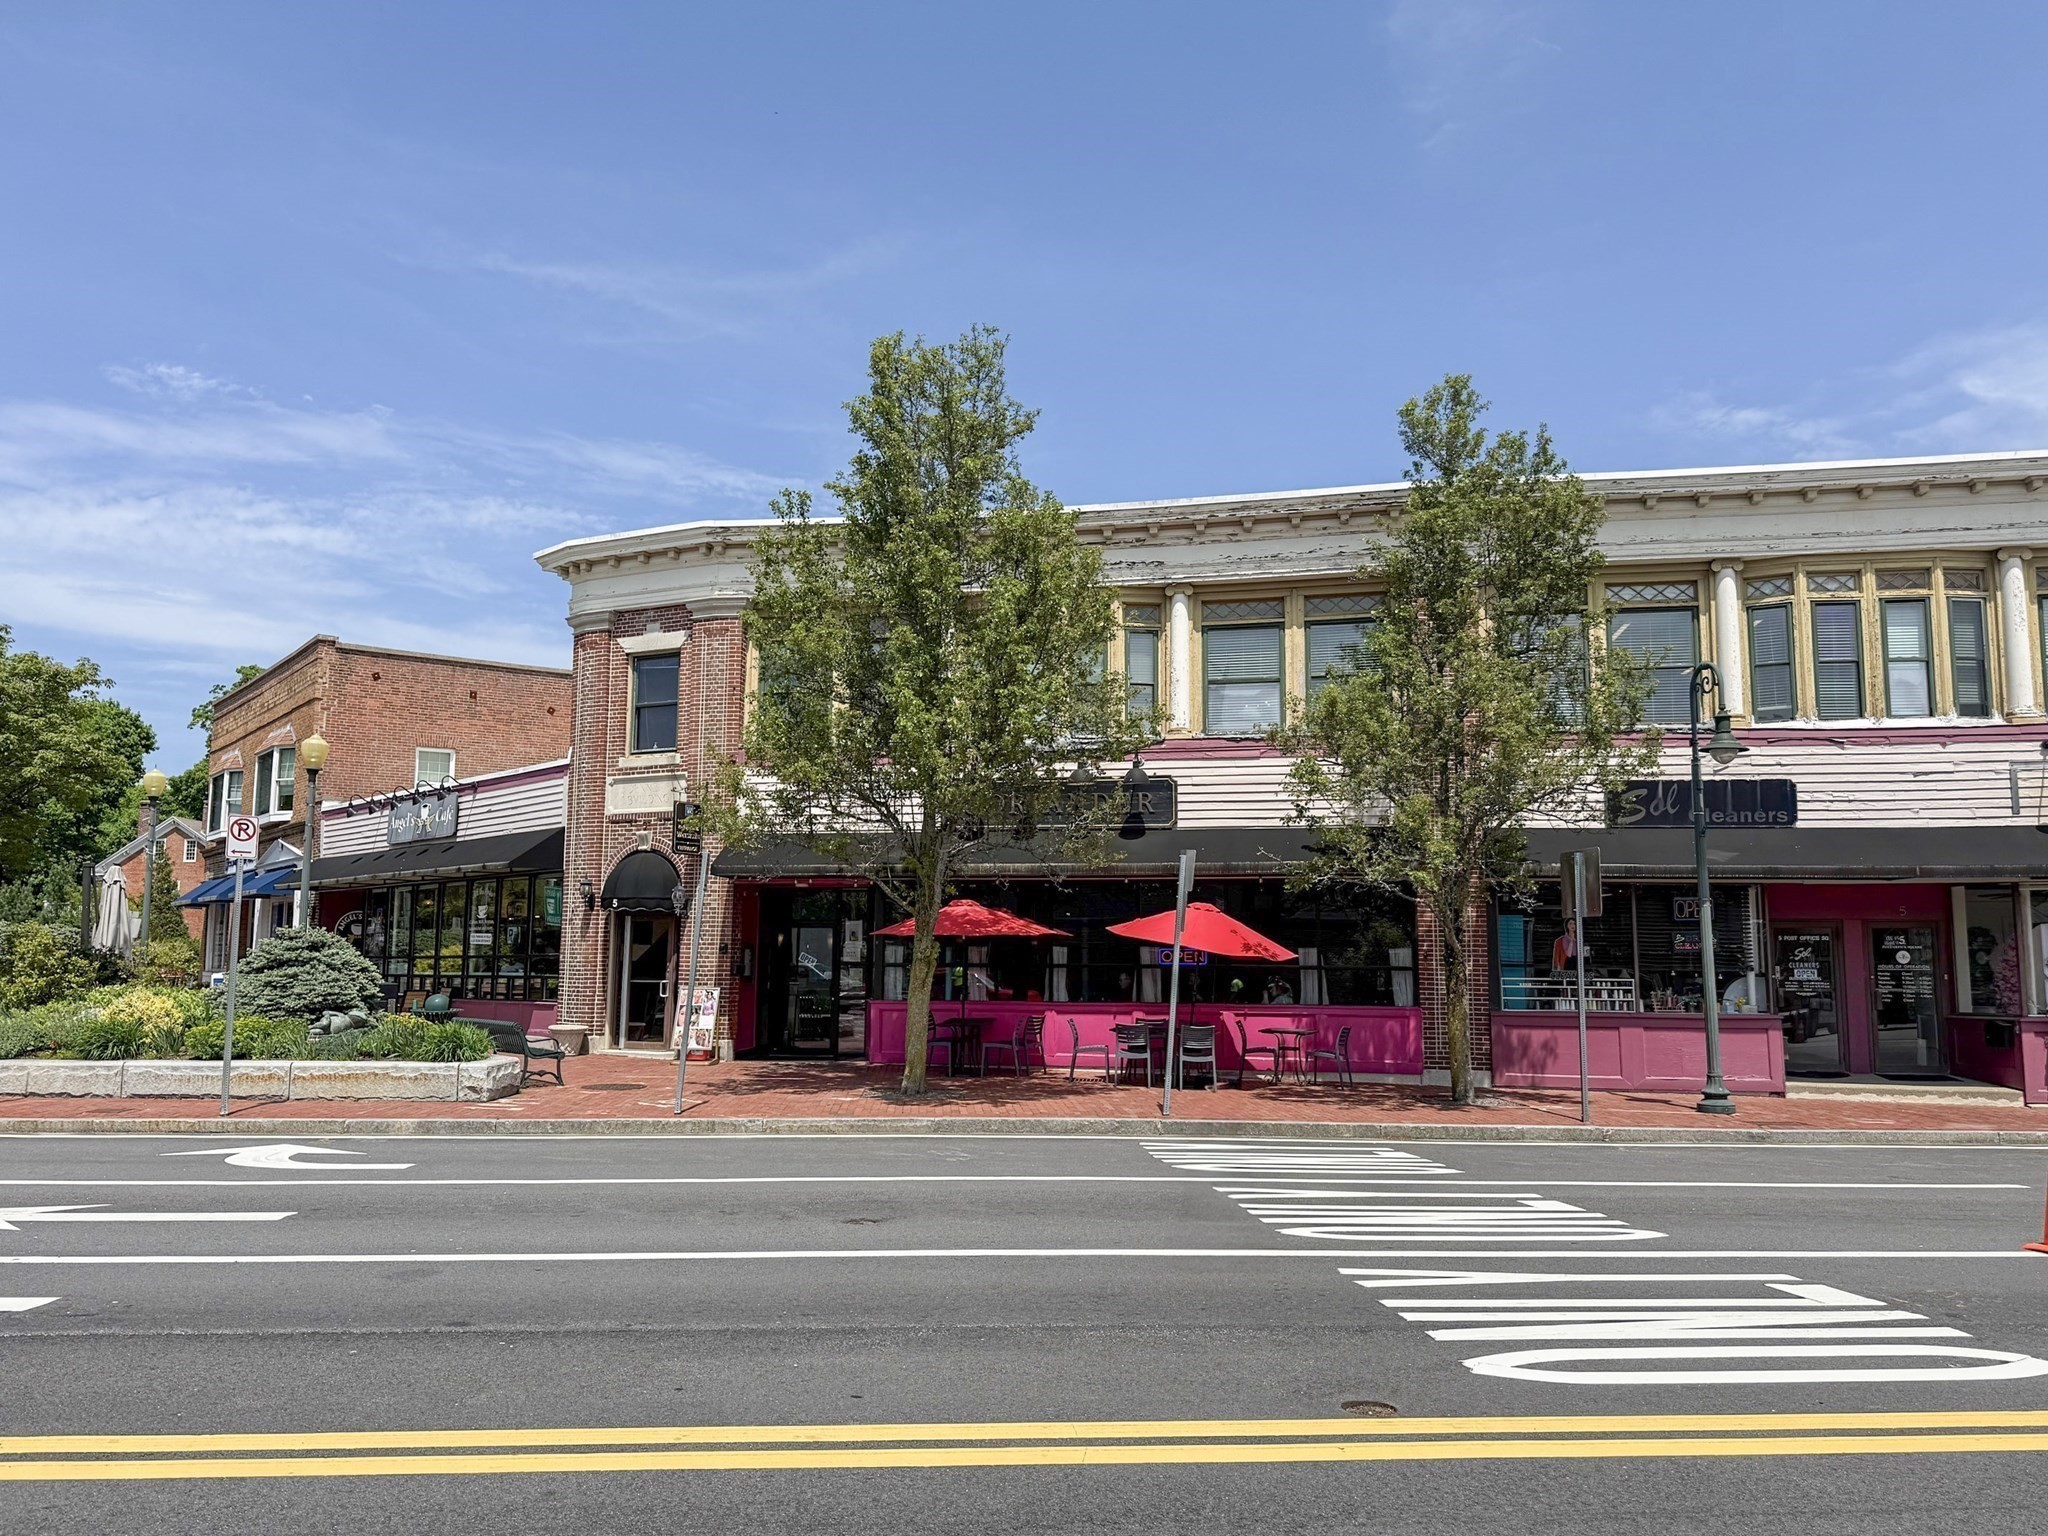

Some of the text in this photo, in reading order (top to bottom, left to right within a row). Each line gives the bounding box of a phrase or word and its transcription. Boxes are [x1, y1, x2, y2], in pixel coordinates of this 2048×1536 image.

[389, 812, 415, 833] Angel's
[612, 898, 618, 908] 5
[1675, 900, 1702, 918] OPE
[1899, 905, 1907, 917] 5
[338, 913, 363, 931] ANGEL'S
[800, 952, 816, 967] OPEN
[1796, 970, 1816, 978] OPEN
